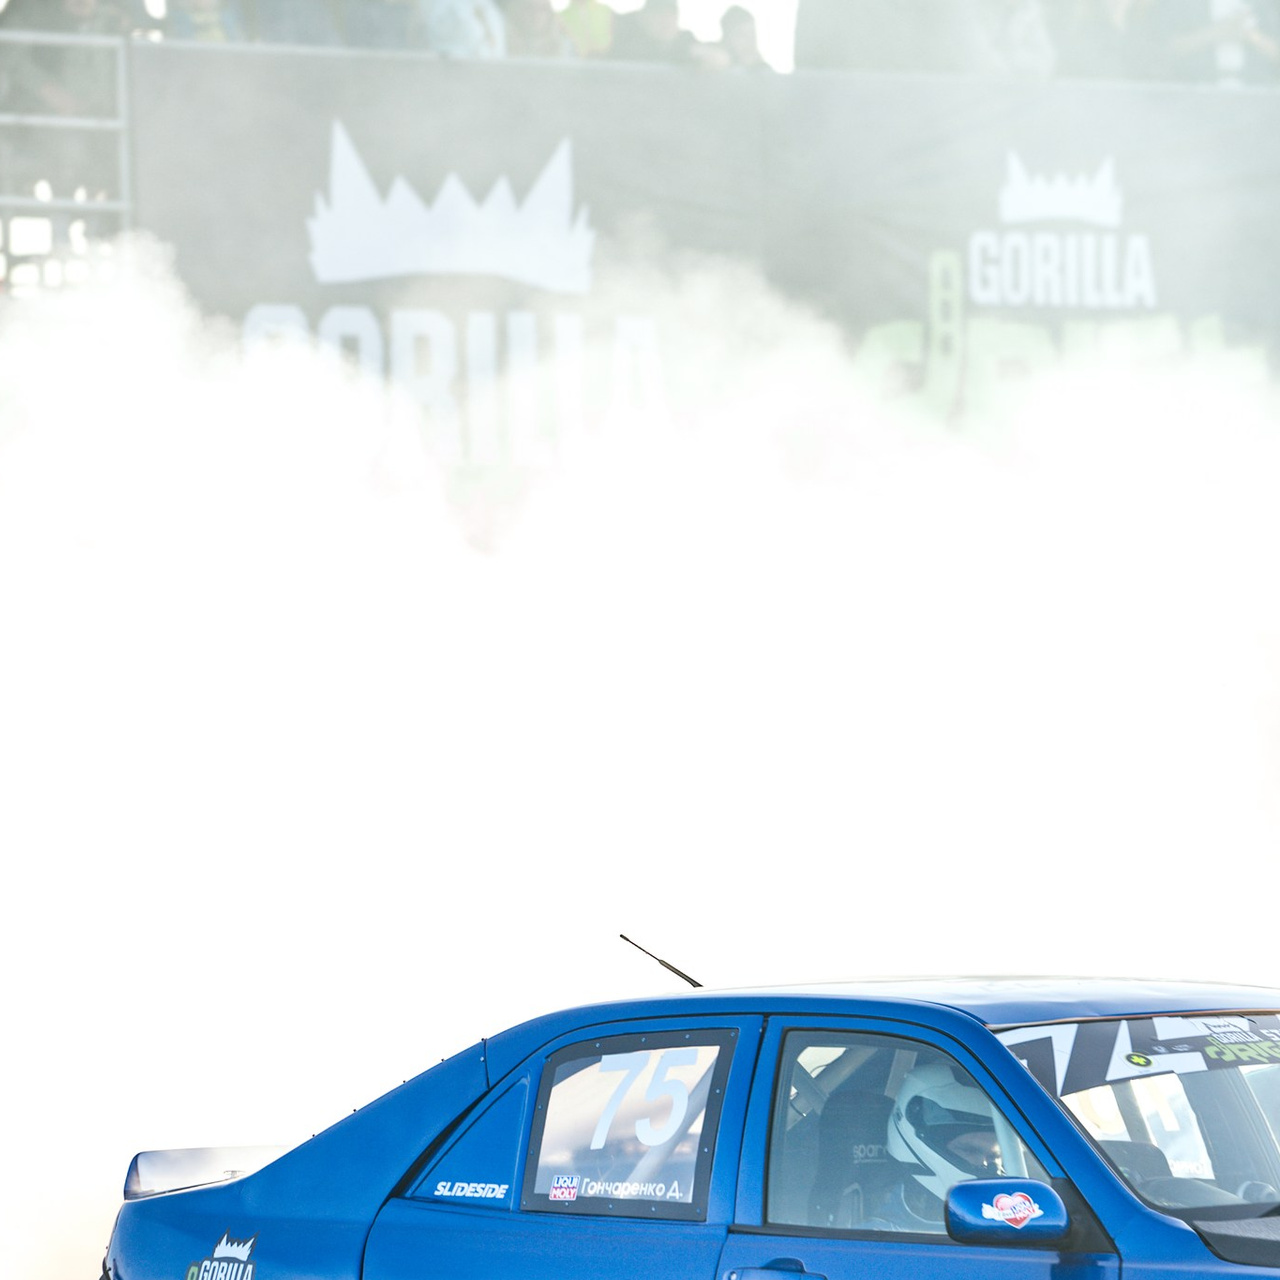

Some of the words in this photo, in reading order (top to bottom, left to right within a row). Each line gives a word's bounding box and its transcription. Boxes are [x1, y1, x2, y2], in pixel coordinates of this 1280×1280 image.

[969, 231, 1156, 307] GORILLA
[1210, 1031, 1263, 1045] GORILLA
[590, 1048, 698, 1150] 75
[434, 1181, 509, 1199] SLIDESIDE
[553, 1176, 578, 1188] LIQUI
[581, 1178, 666, 1199] Гончаренко
[666, 1180, 683, 1199] Д.
[551, 1187, 577, 1199] MOLY
